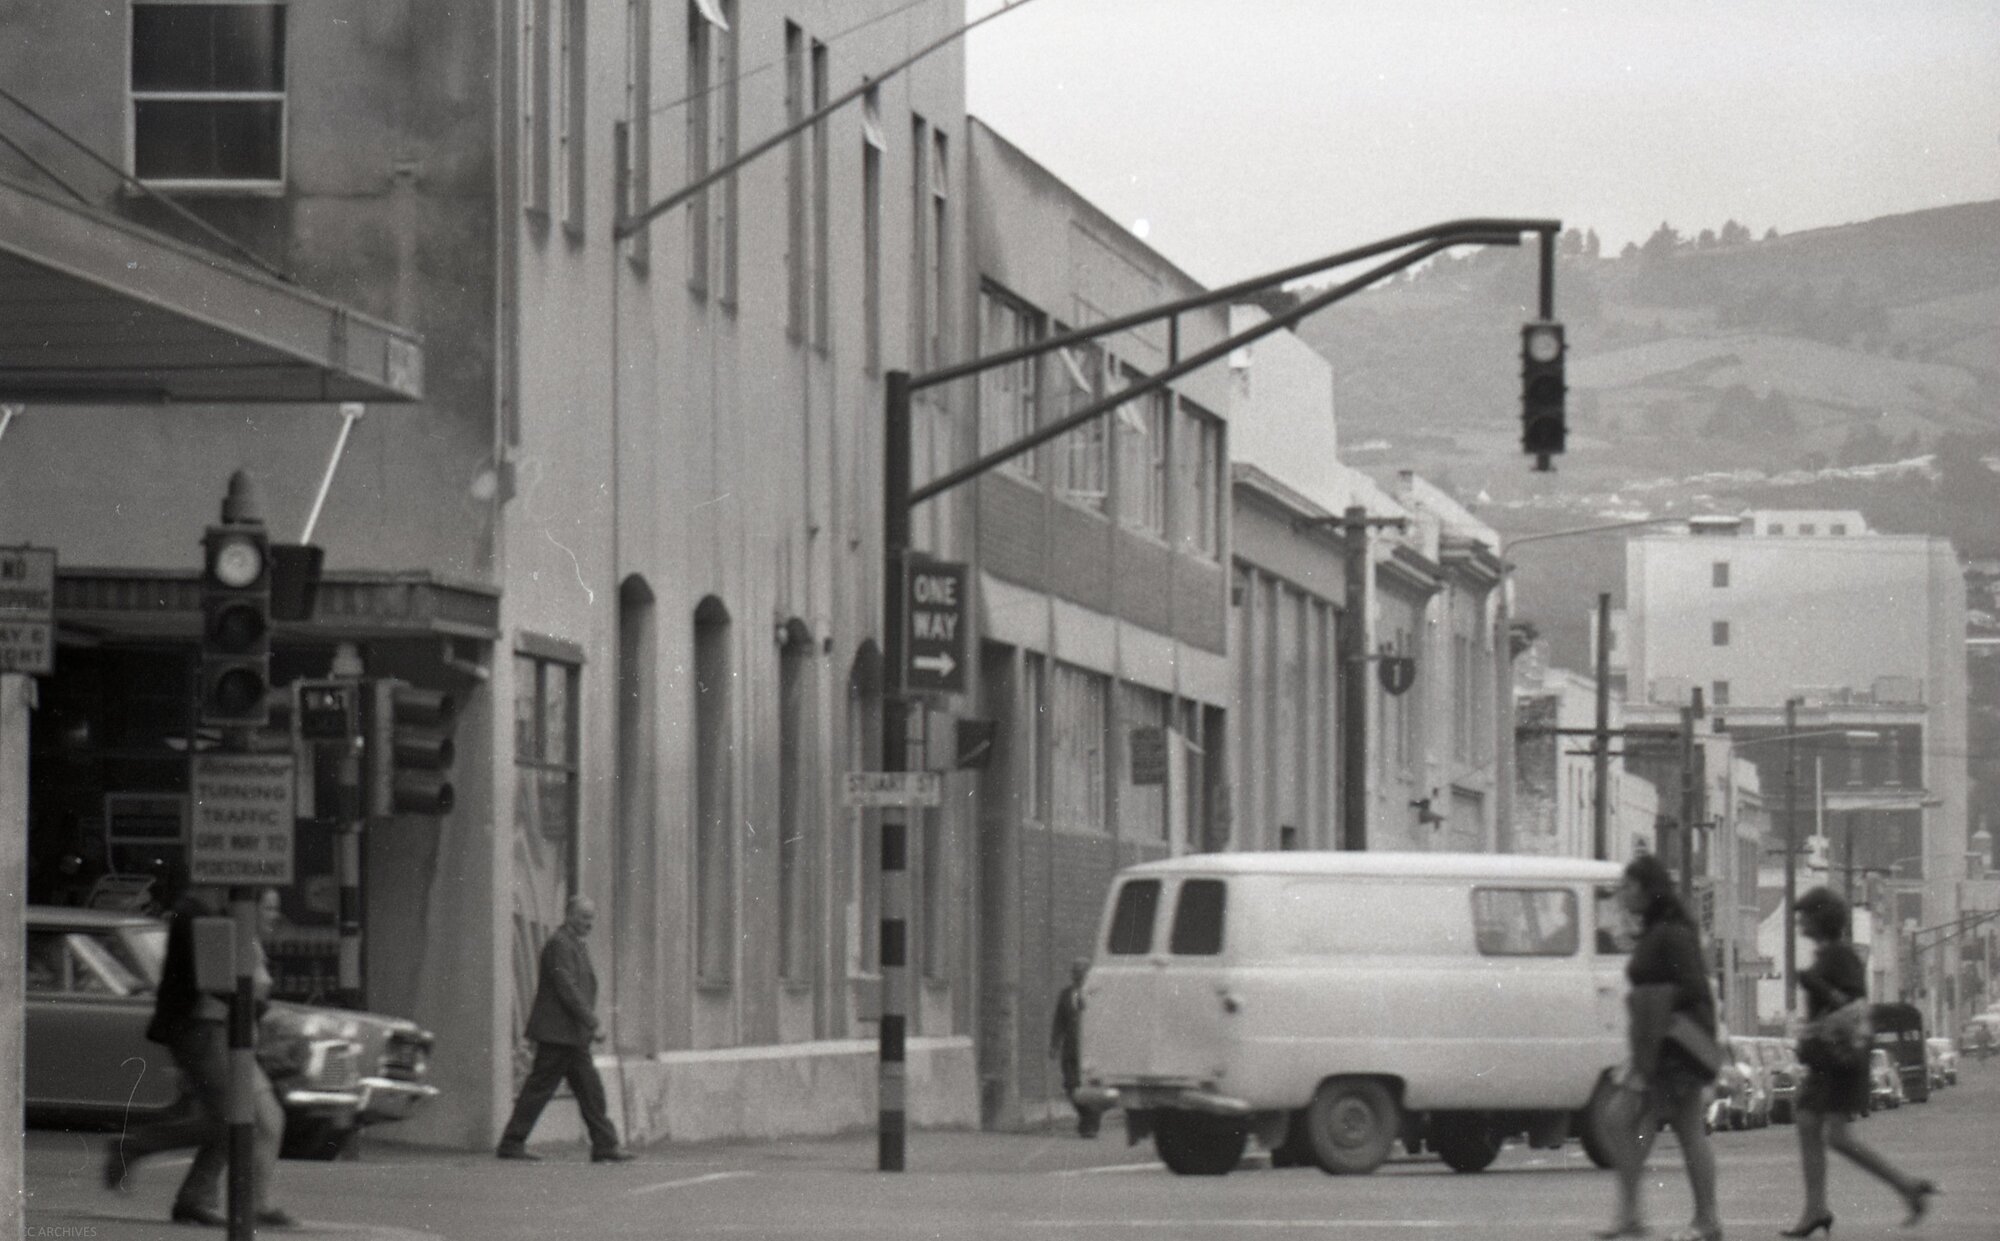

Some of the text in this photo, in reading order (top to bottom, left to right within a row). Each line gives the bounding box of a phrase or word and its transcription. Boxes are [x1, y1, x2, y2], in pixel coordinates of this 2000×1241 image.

[913, 573, 958, 605] ONE
[911, 611, 960, 641] WAY
[198, 783, 287, 800] TURNING
[203, 809, 279, 826] TRAFFIC
